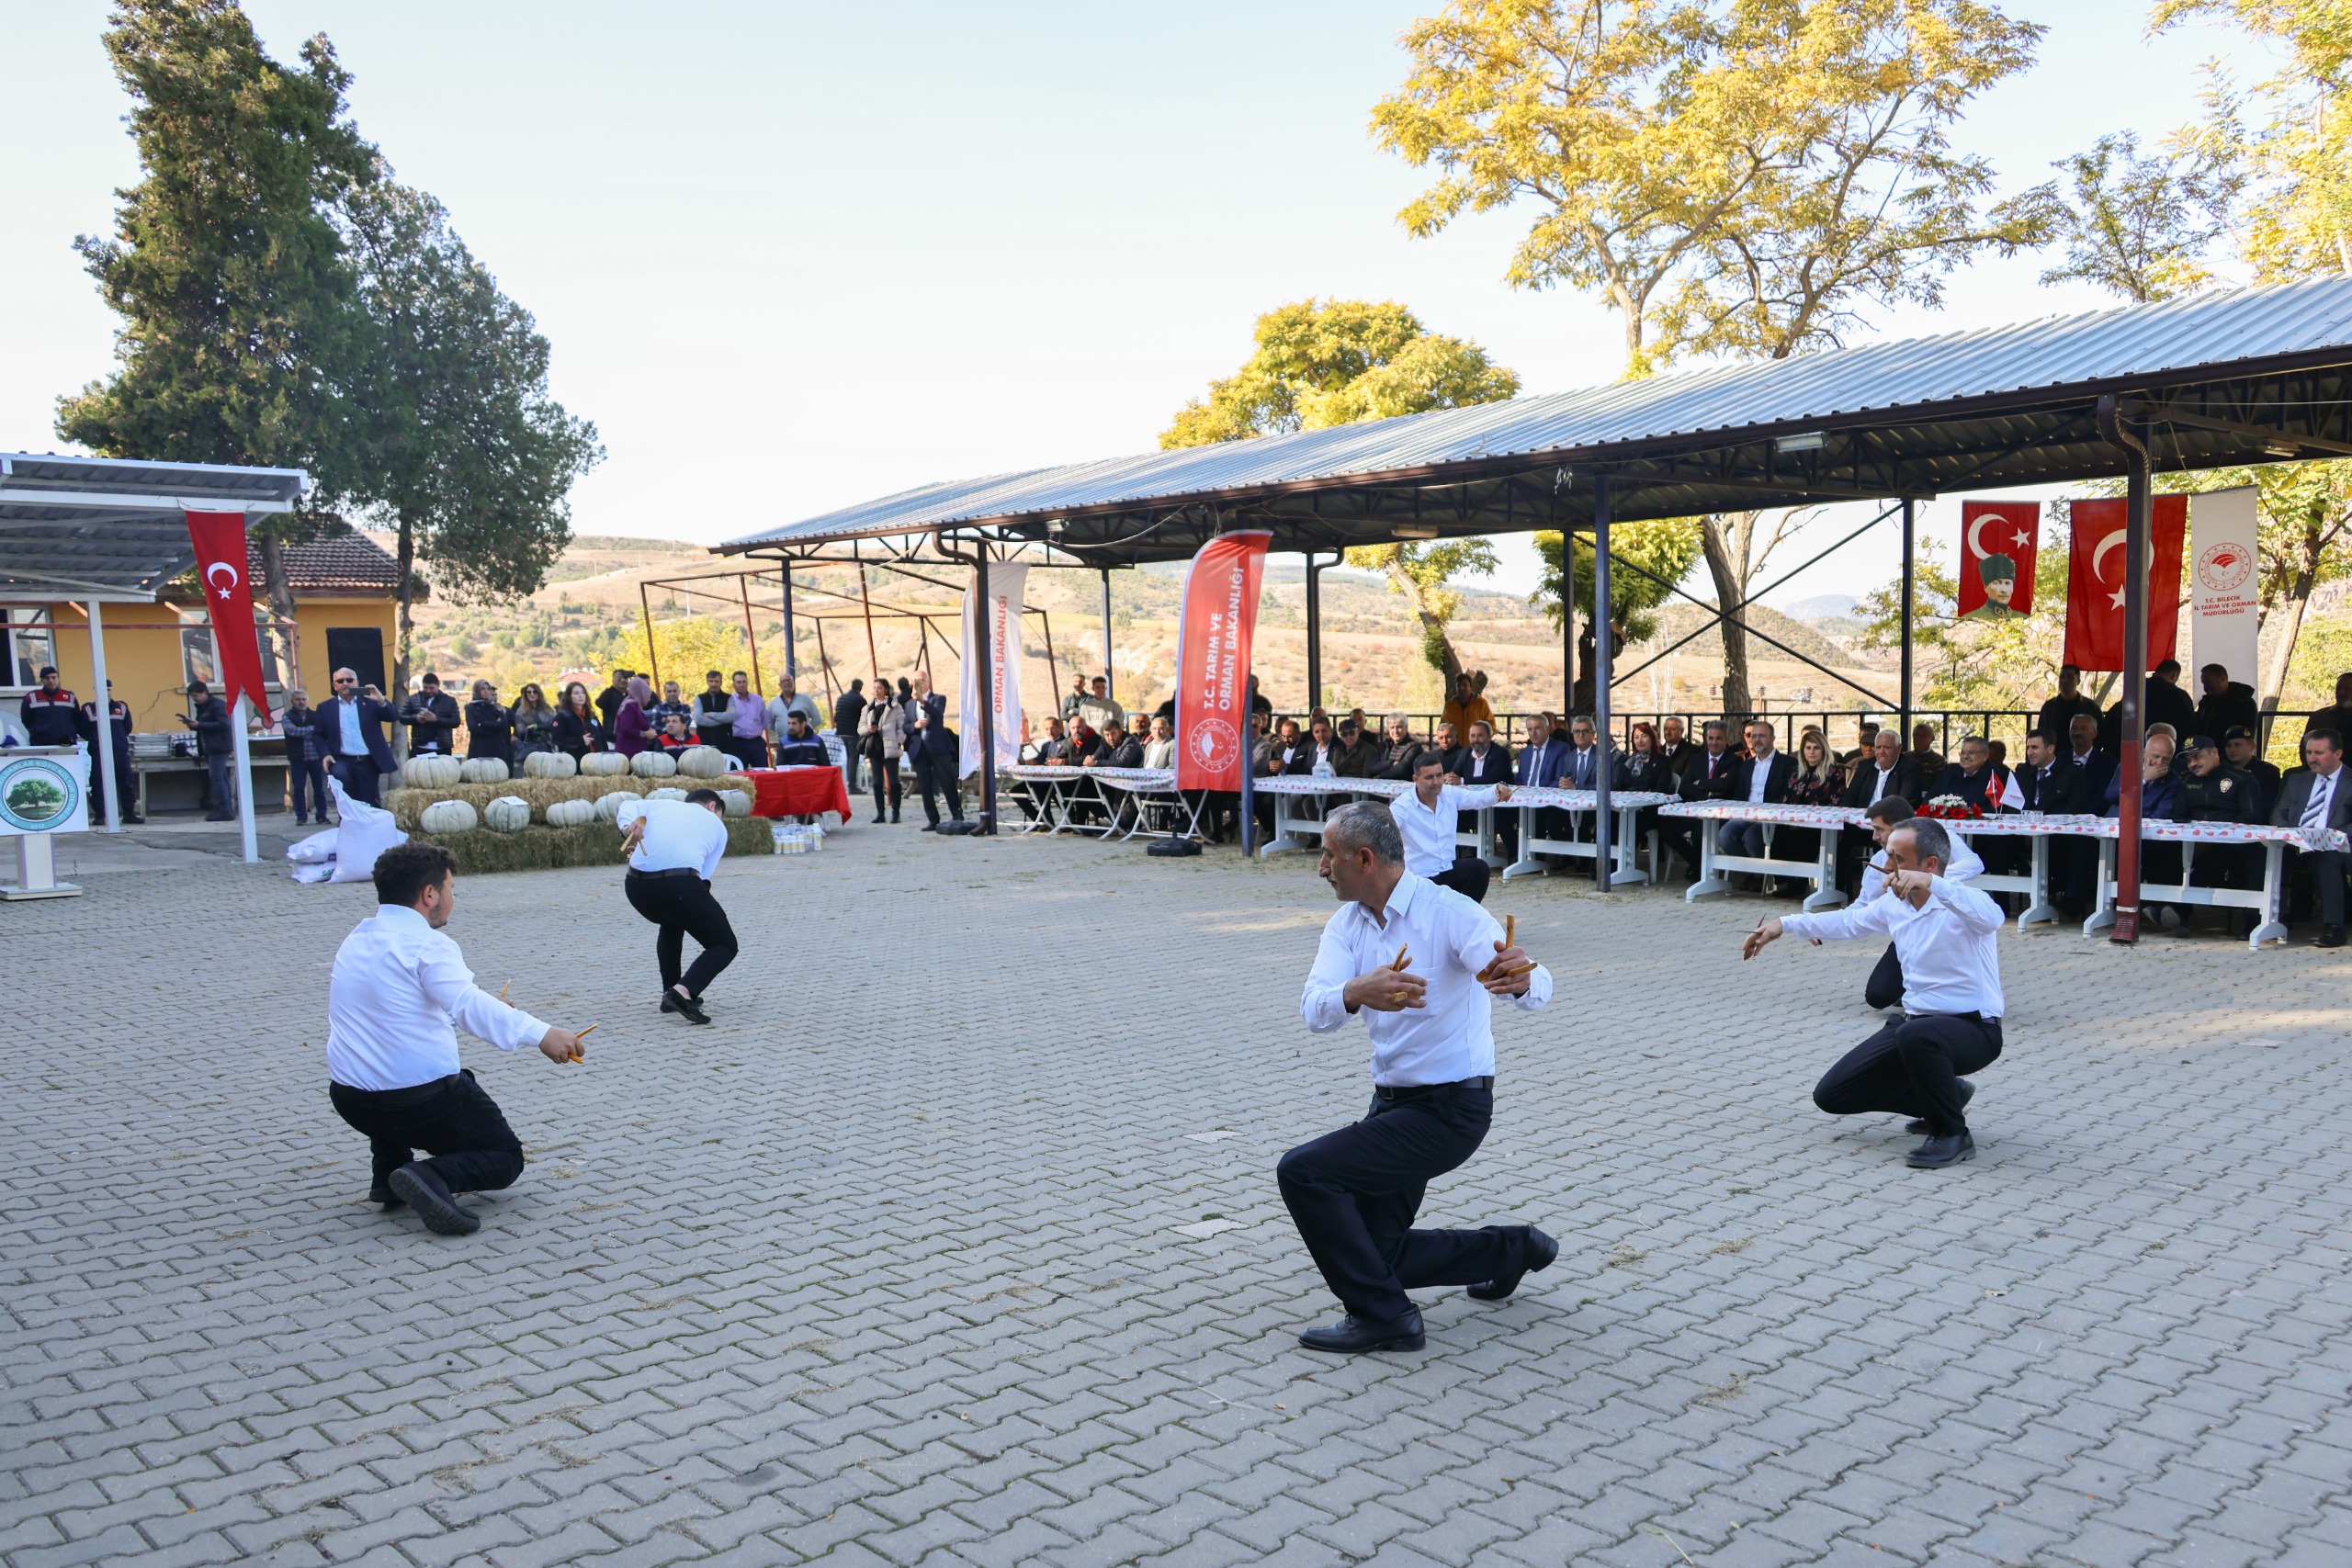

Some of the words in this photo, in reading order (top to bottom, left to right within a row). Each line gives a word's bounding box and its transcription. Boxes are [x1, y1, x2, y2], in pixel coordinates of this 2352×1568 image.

[1224, 567, 1244, 649] BAKANLIĞI
[2202, 607, 2245, 616] MÜDÜRLÜĞÜ
[2217, 594, 2241, 603] BİLECİK
[1209, 613, 1223, 632] VE
[1205, 636, 1220, 682] TARIM
[994, 667, 1004, 714] ORMAN
[1204, 685, 1216, 709] T.C.
[1218, 653, 1235, 711] ORMAN
